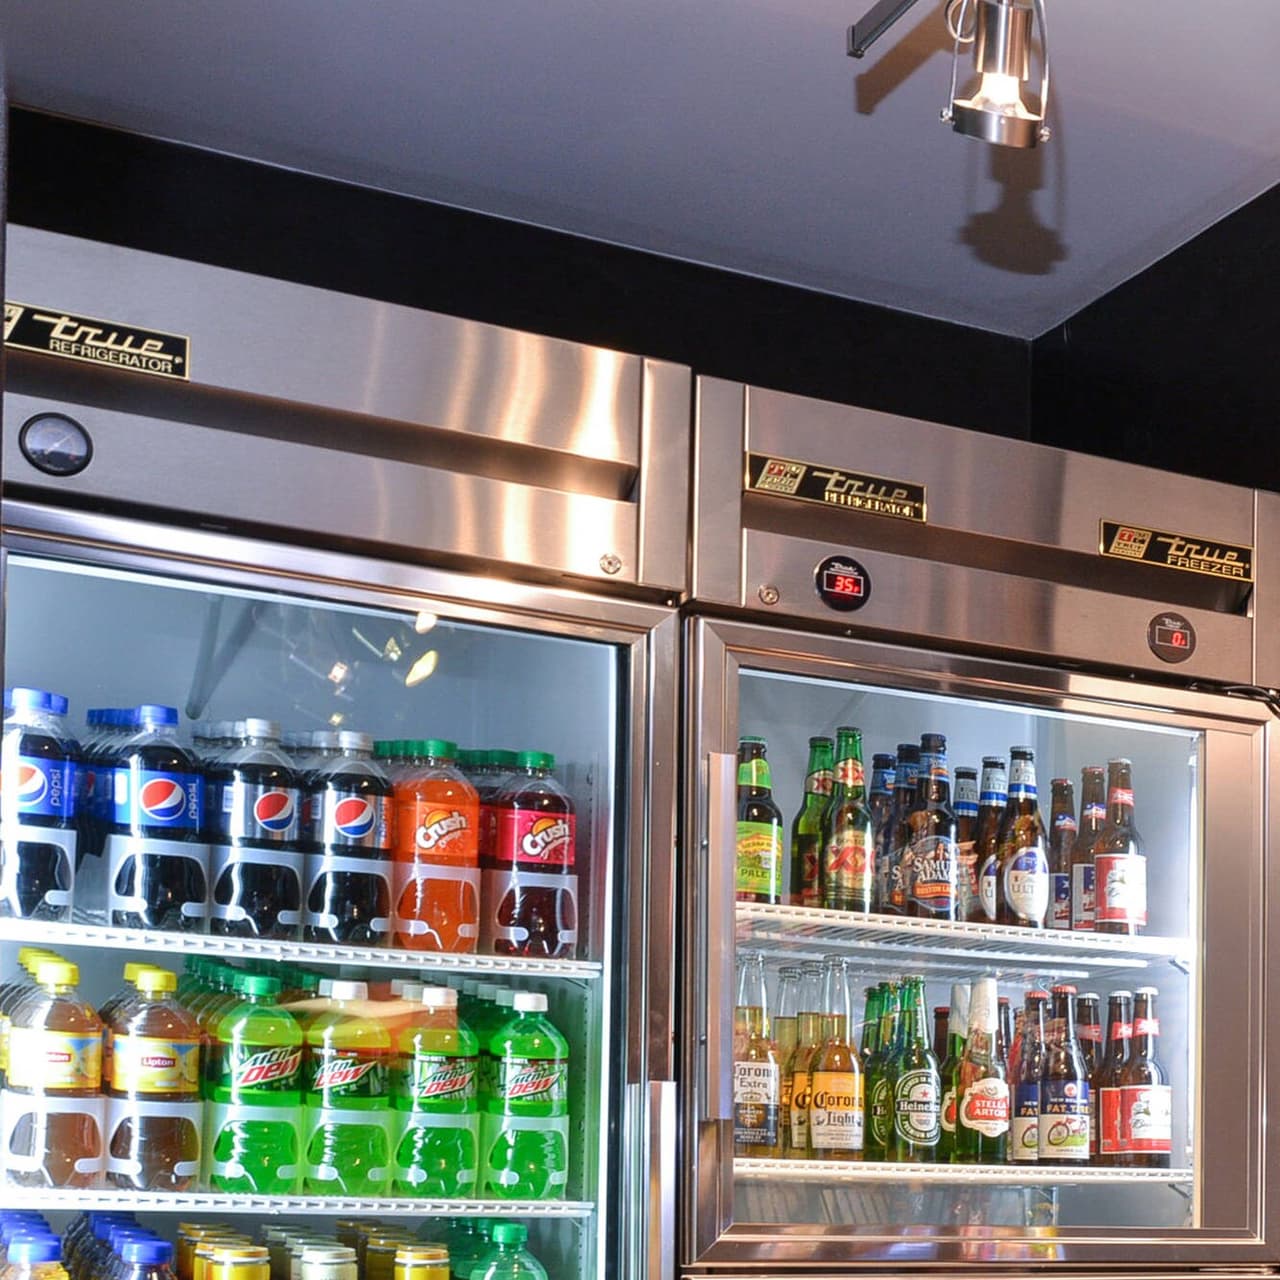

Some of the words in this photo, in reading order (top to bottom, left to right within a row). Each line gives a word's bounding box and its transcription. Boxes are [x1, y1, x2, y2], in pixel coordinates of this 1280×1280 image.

[49, 338, 173, 374] REFRIGERATOR
[824, 490, 914, 517] REFRIGERATOR
[1167, 555, 1244, 577] FREEZER
[415, 810, 469, 850] Crush
[520, 818, 571, 857] Crush
[141, 1057, 175, 1068] Lipton
[974, 1099, 1008, 1109] STELLA
[1046, 1103, 1067, 1113] FAT
